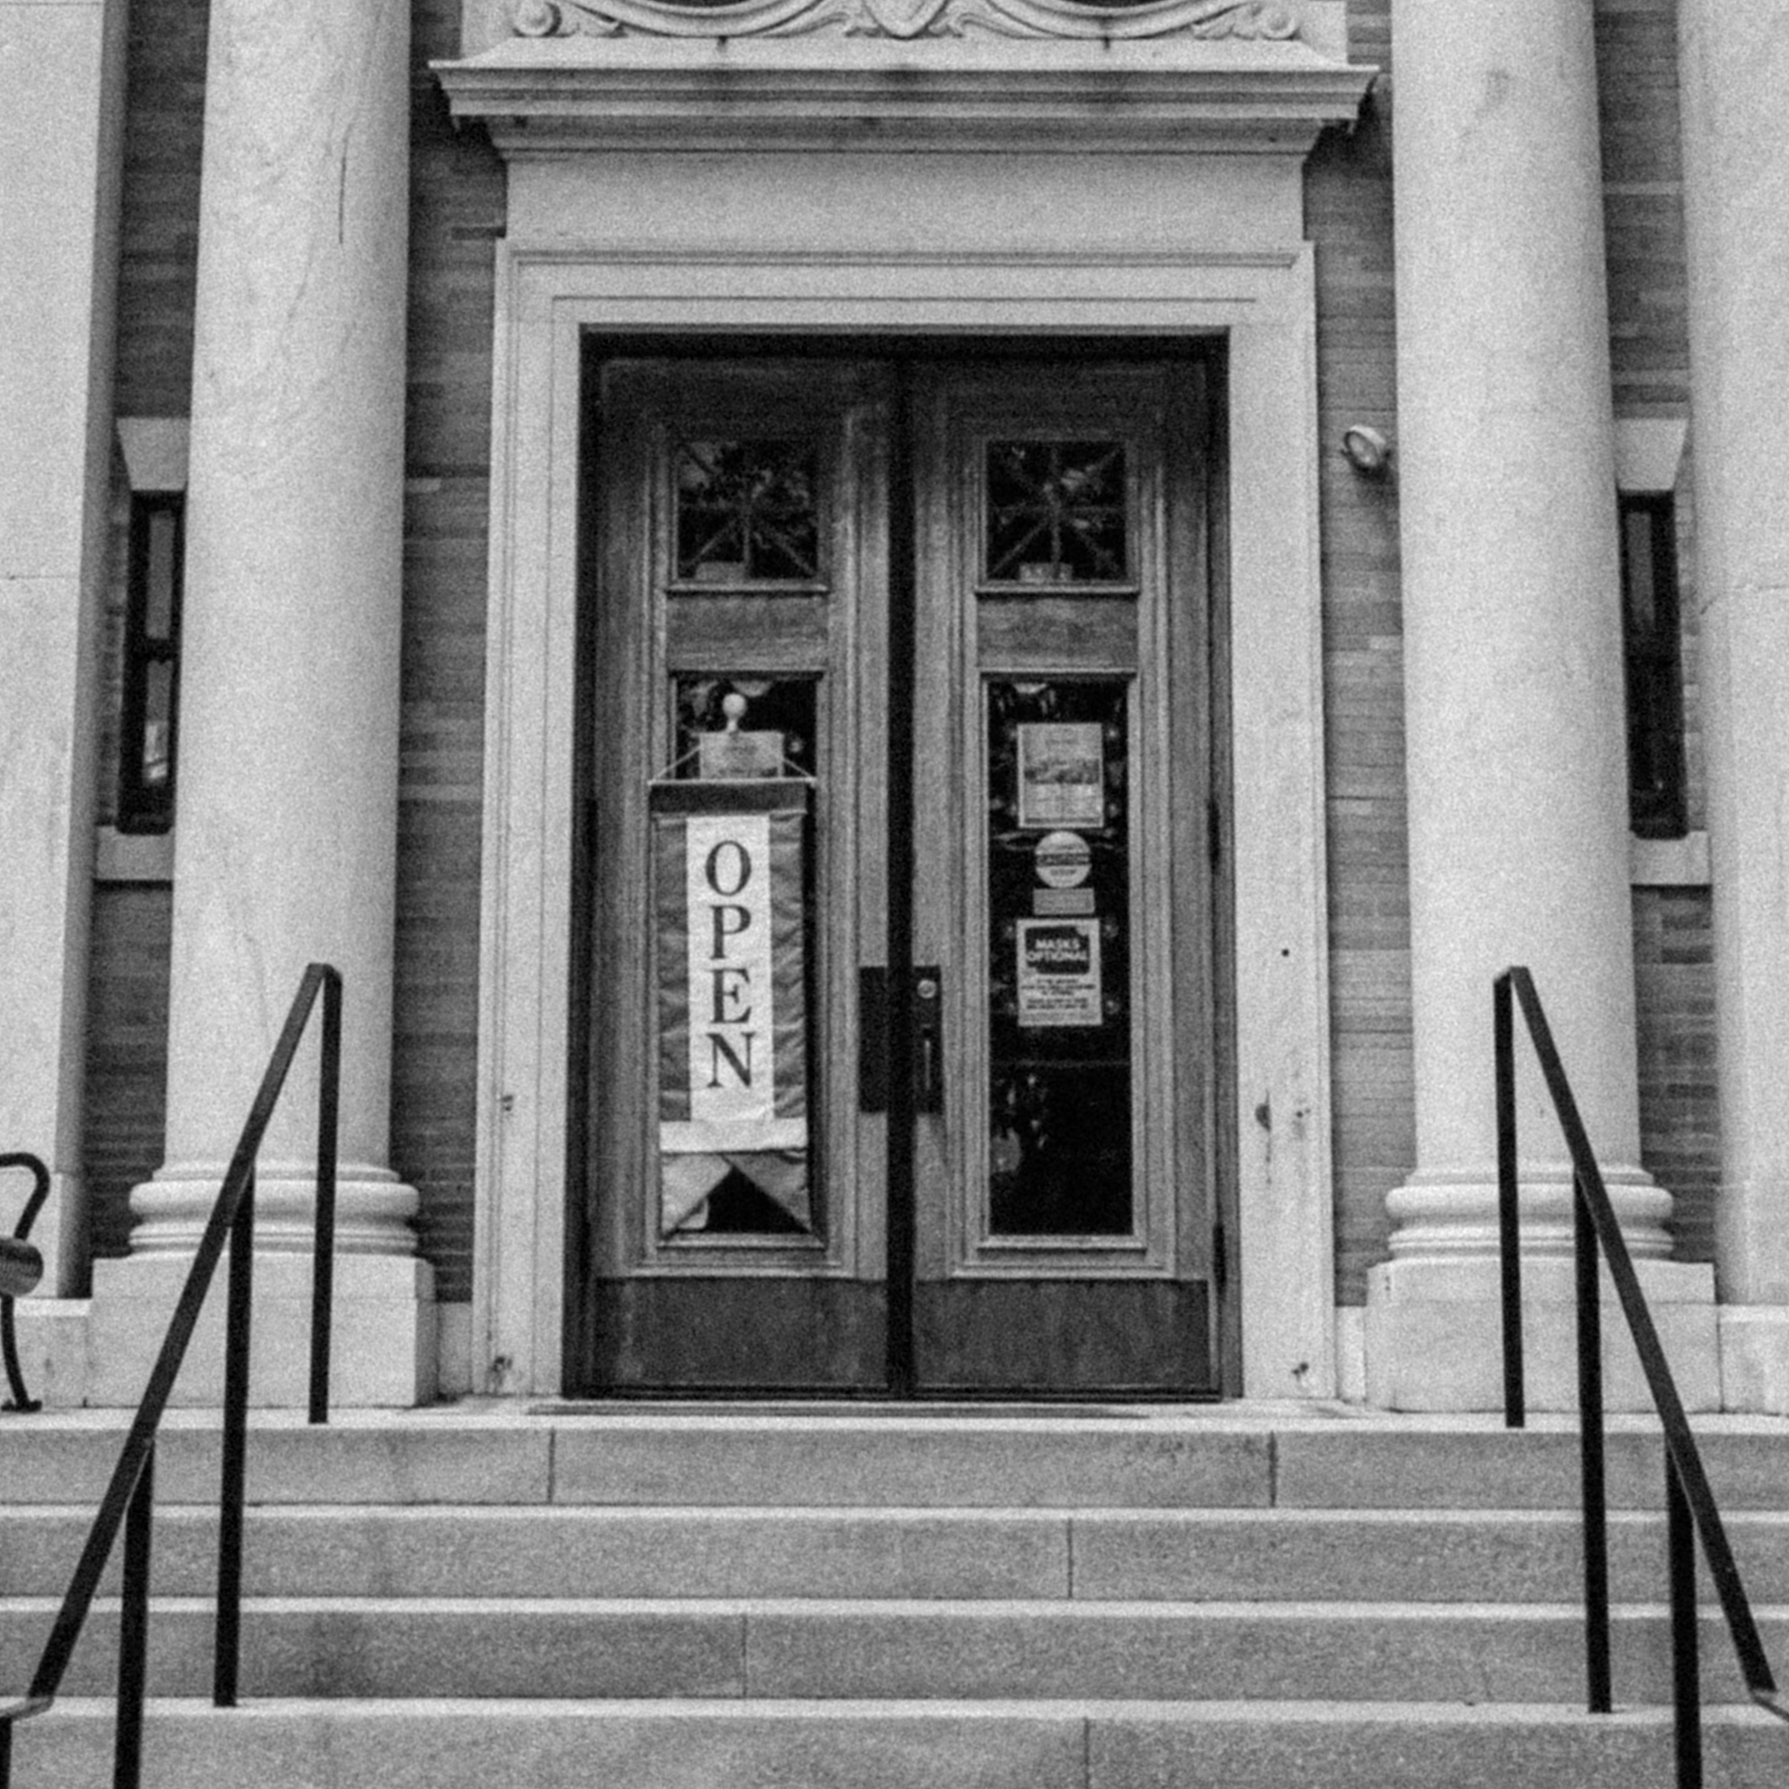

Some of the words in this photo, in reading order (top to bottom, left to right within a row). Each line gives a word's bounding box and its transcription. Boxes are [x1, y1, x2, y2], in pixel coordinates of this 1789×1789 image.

[1035, 938, 1080, 950] MASKS
[1026, 950, 1088, 963] OPTIONAL
[704, 839, 756, 1088] OPEN
